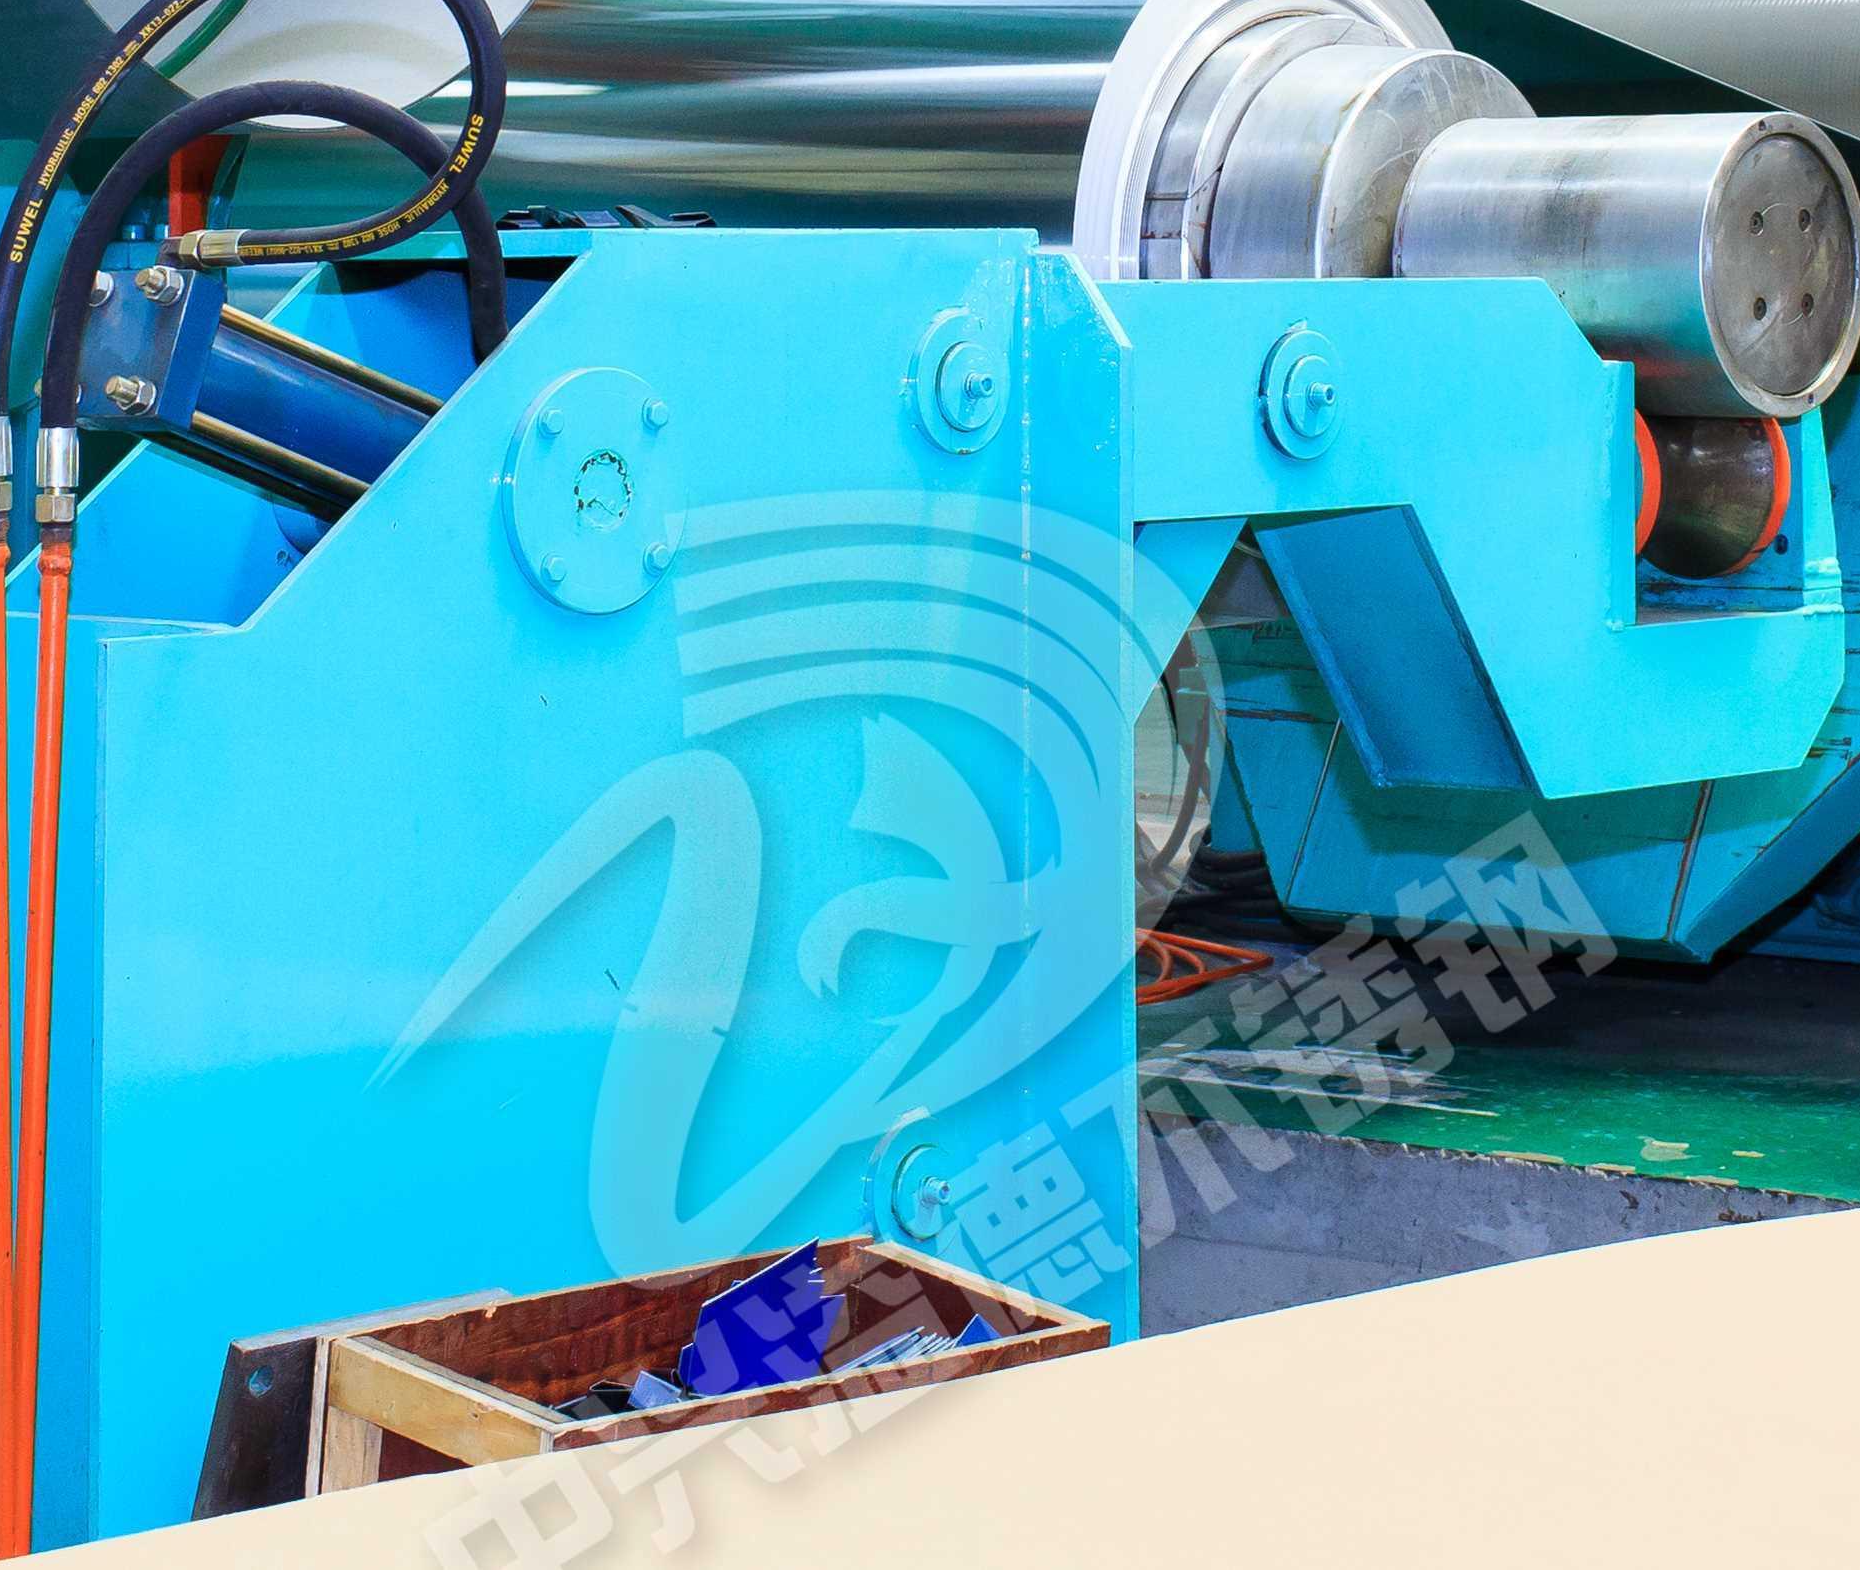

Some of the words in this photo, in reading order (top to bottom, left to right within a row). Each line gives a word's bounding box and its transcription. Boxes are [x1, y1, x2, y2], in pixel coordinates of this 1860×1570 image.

[449, 114, 484, 173] SUWEL
[10, 198, 44, 262] SUWEL
[38, 128, 74, 187] HYDRAULIC
[73, 94, 94, 123] HOSE
[404, 182, 450, 223] HYDRAULIC
[378, 220, 401, 239] HOSE
